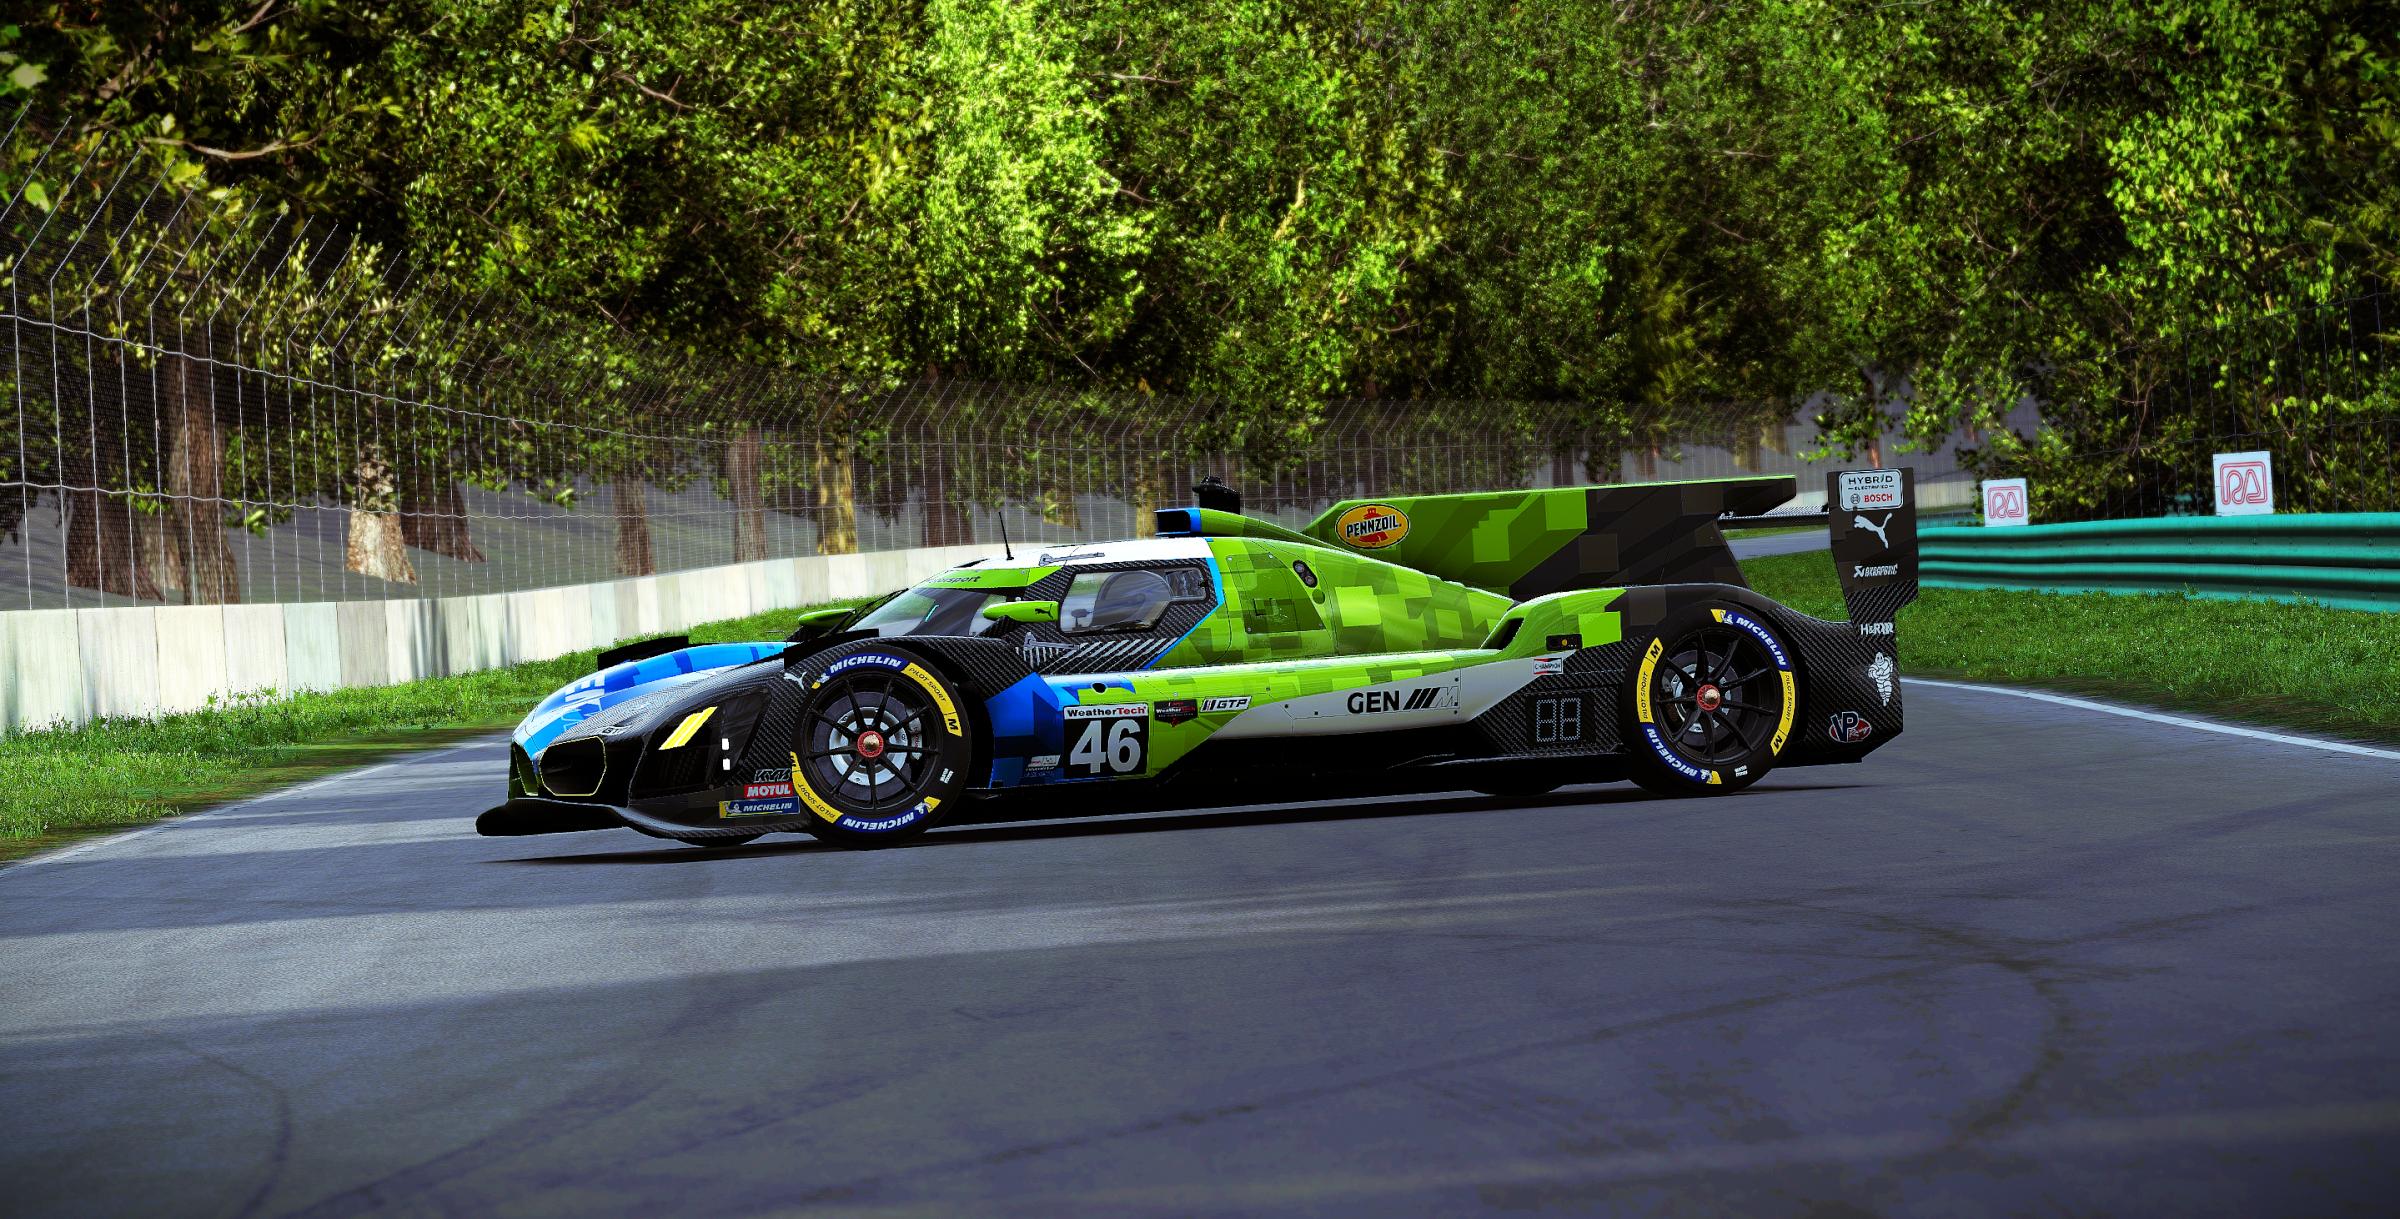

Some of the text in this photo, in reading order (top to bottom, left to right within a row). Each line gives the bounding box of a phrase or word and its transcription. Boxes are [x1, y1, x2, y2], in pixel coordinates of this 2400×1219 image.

[1848, 474, 1893, 485] HYBRID
[1864, 494, 1893, 503] BOSCH
[1346, 514, 1398, 539] PENNZOIL
[1650, 644, 1661, 659] M
[1736, 616, 1787, 667] MICHELIN
[830, 655, 902, 674] MICHELIN
[908, 667, 947, 702] PILOT SPORT
[1216, 699, 1248, 709] GTP
[1347, 690, 1400, 714] GEN
[1640, 672, 1649, 719] PILOT SPORT
[1785, 675, 1793, 721] PILOT SPORT
[1067, 706, 1146, 718] WeatherTech
[1070, 719, 1141, 774] 46
[1647, 728, 1698, 778] MICHELIN
[753, 768, 791, 783] KYB
[747, 784, 790, 798] MOTUL
[798, 783, 835, 819] PILOT SPORT
[743, 802, 793, 813] MICHELIN
[843, 811, 915, 831] MICHELIN
